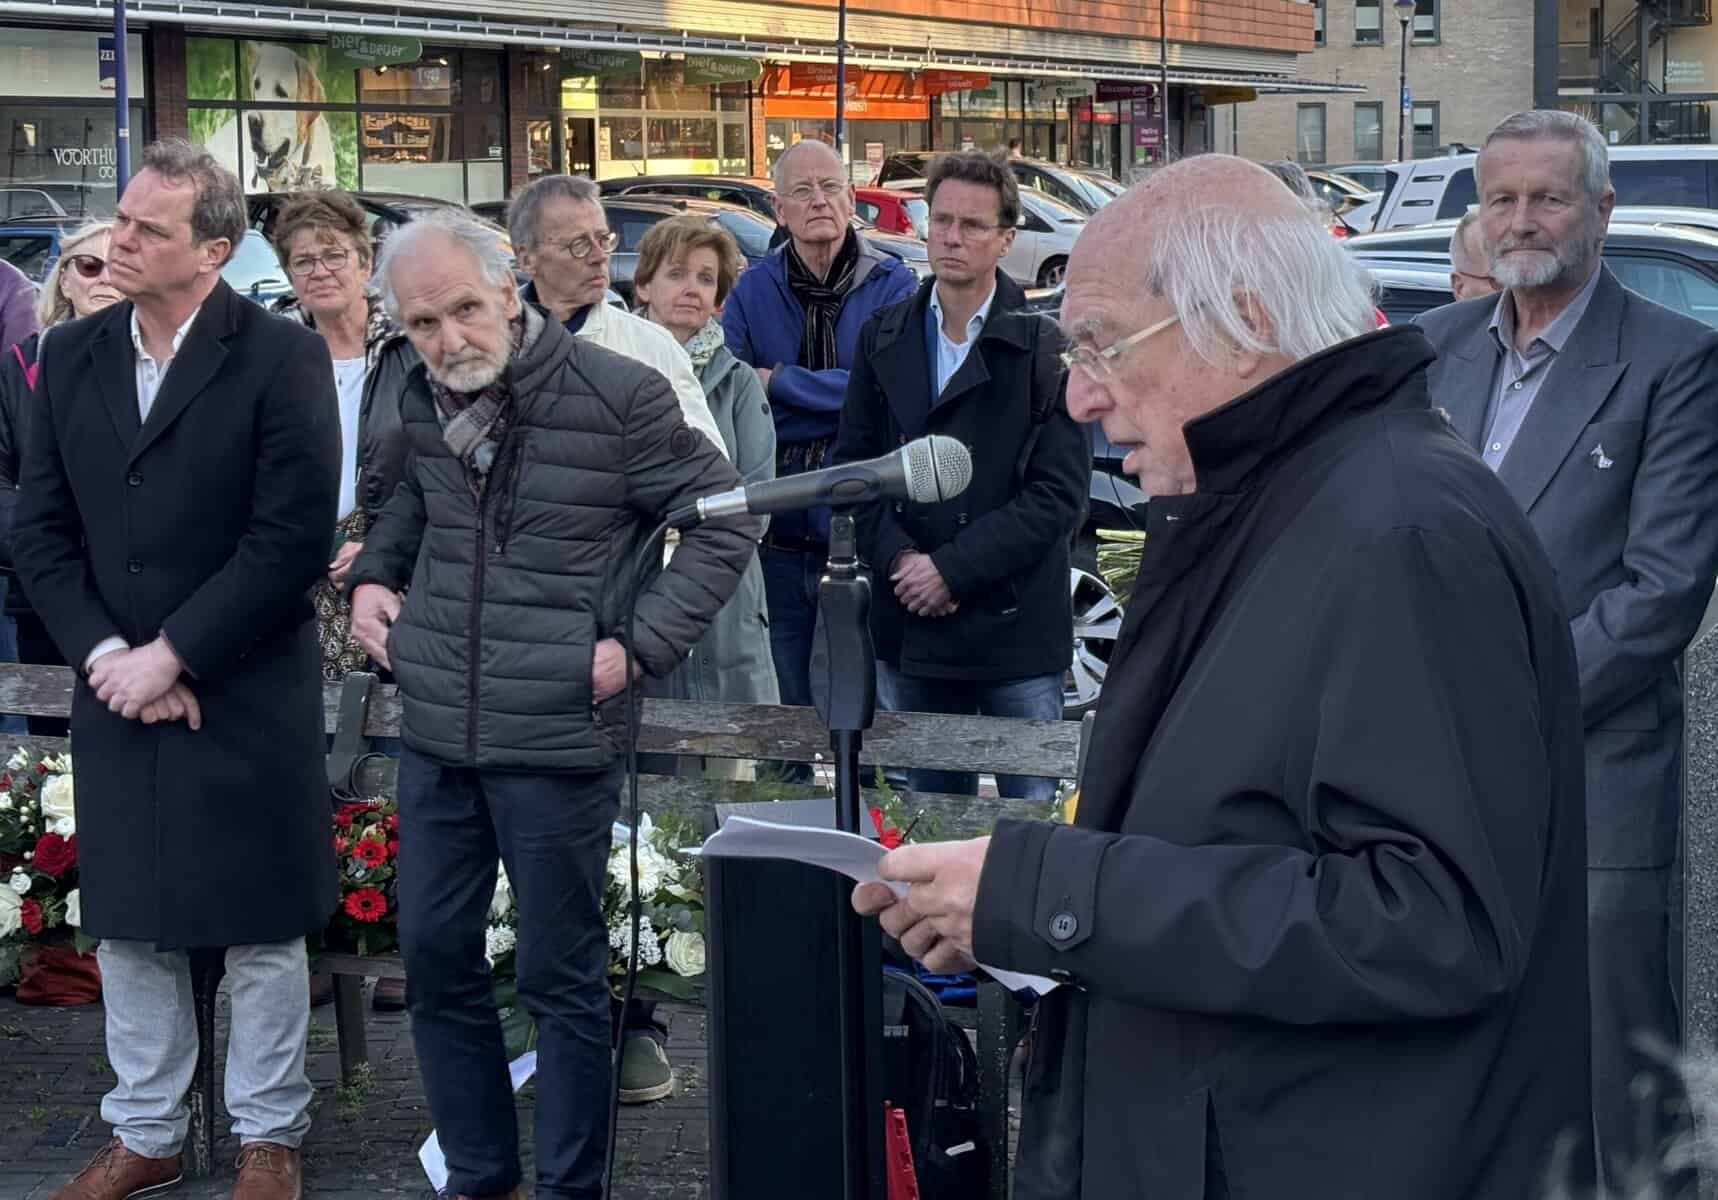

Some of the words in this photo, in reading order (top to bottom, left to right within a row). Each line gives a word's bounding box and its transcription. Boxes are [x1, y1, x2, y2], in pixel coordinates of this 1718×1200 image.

[100, 49, 115, 61] ZEI
[53, 147, 117, 166] VOORTHU
[99, 166, 117, 178] OO
